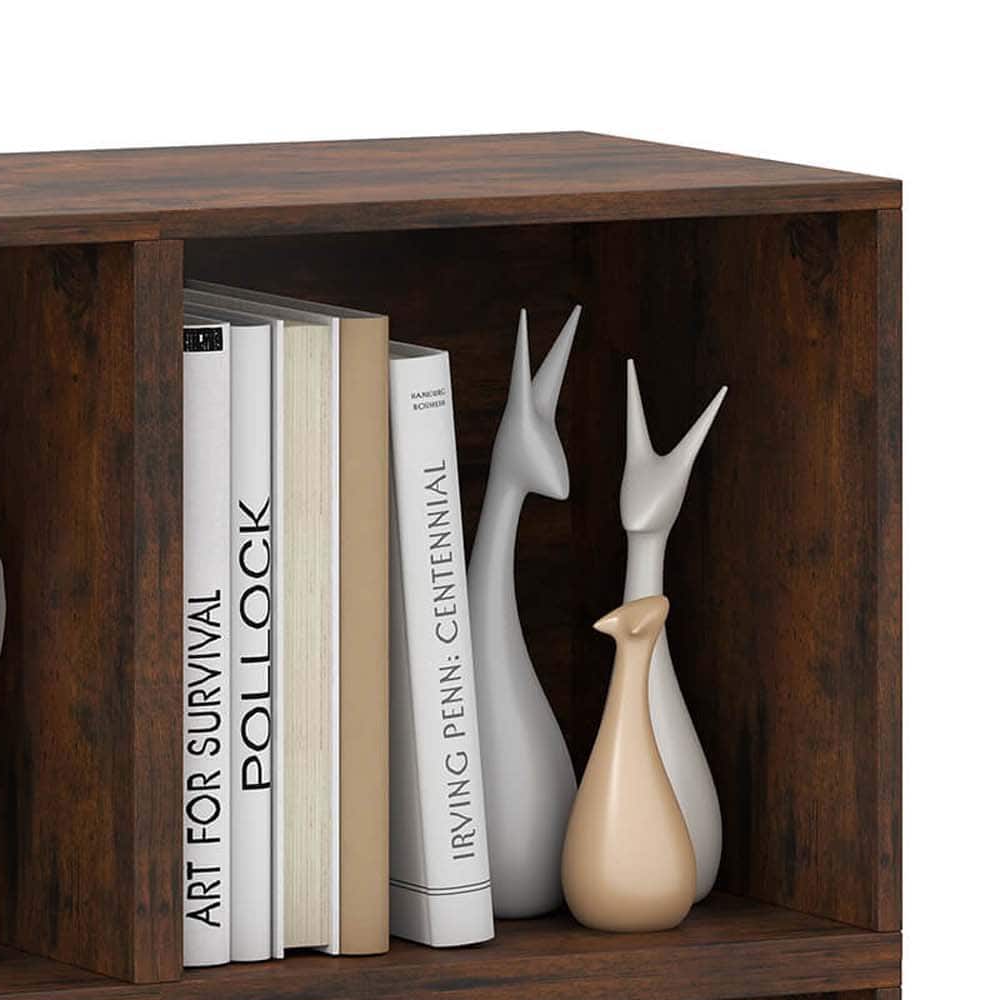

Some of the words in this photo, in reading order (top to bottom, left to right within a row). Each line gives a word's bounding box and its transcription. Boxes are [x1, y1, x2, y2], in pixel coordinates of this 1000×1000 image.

[423, 459, 458, 644] CENTENNIAL
[187, 589, 222, 757] SURVIVAL
[238, 496, 271, 791] POLLOCK
[439, 655, 466, 739] PENN:
[185, 770, 221, 844] FOR
[445, 751, 475, 860] IRVING
[185, 862, 221, 927] ART
